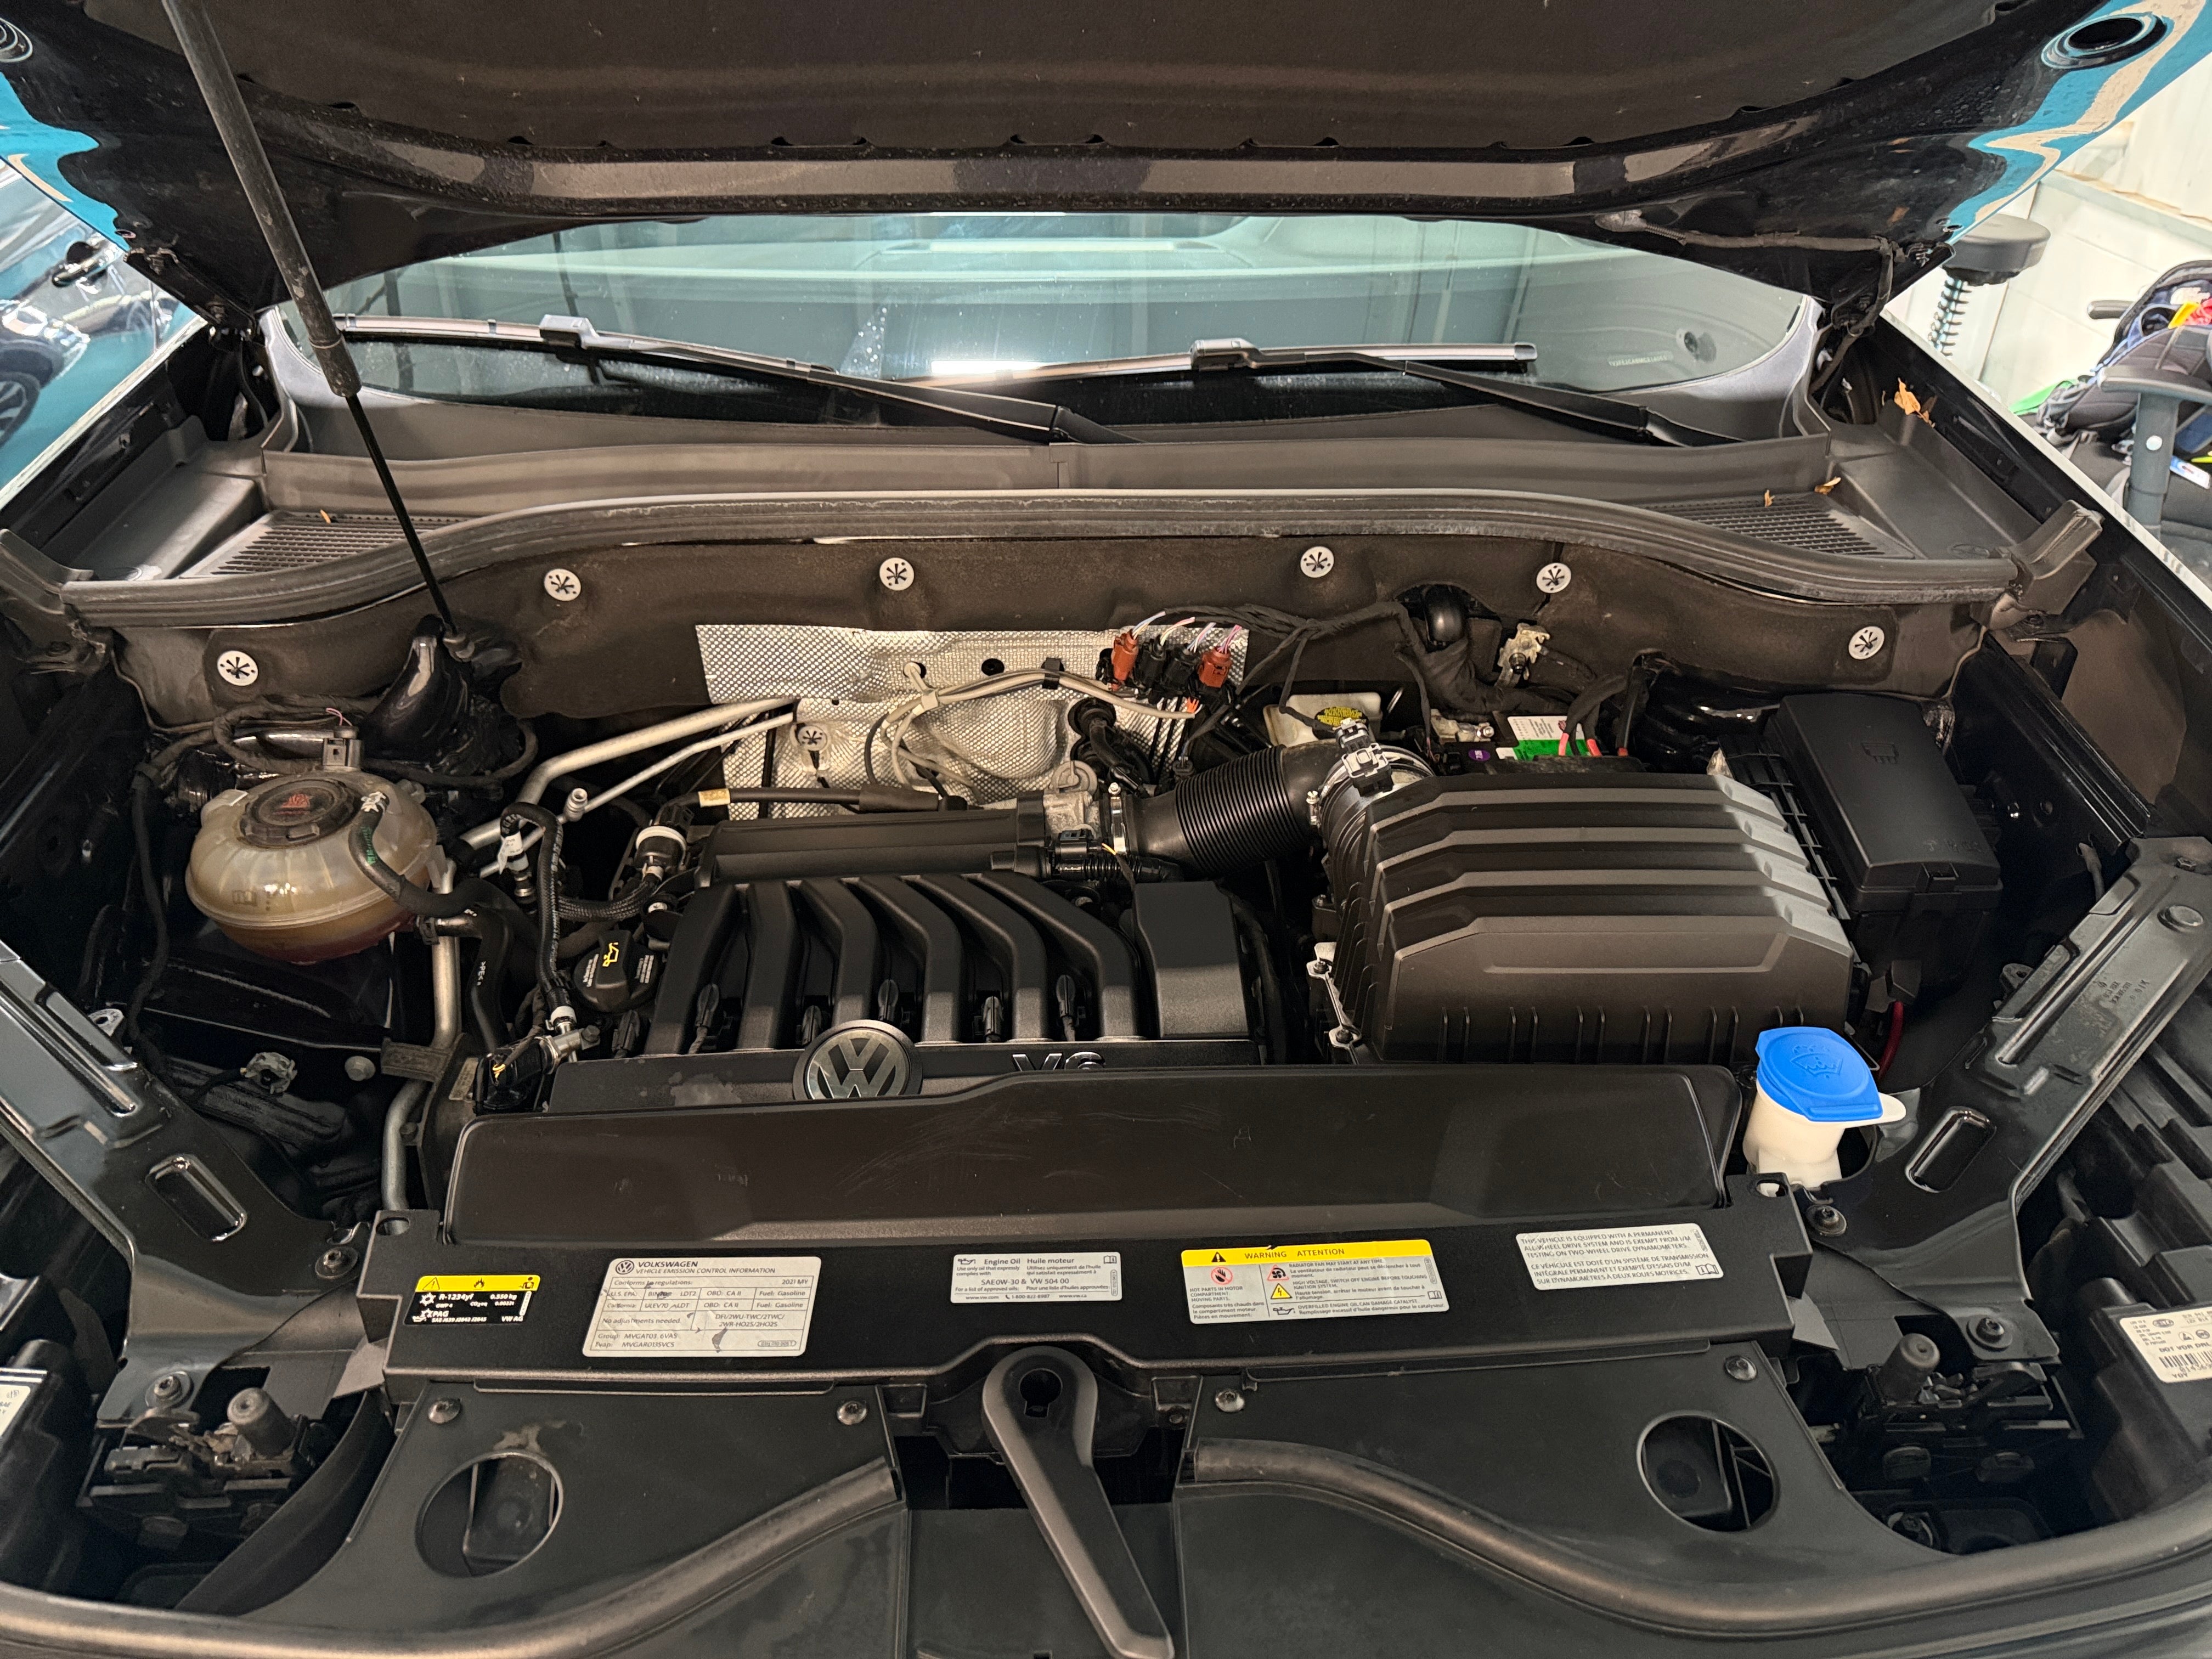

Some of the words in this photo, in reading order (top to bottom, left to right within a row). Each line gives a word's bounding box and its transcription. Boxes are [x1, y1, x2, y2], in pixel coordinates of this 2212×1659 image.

[1244, 1251, 1286, 1259] WARNING
[1297, 1249, 1345, 1257] ATTENTION
[1660, 1253, 1709, 1261] TRANSMISSION
[439, 1293, 474, 1301] R-1234yf
